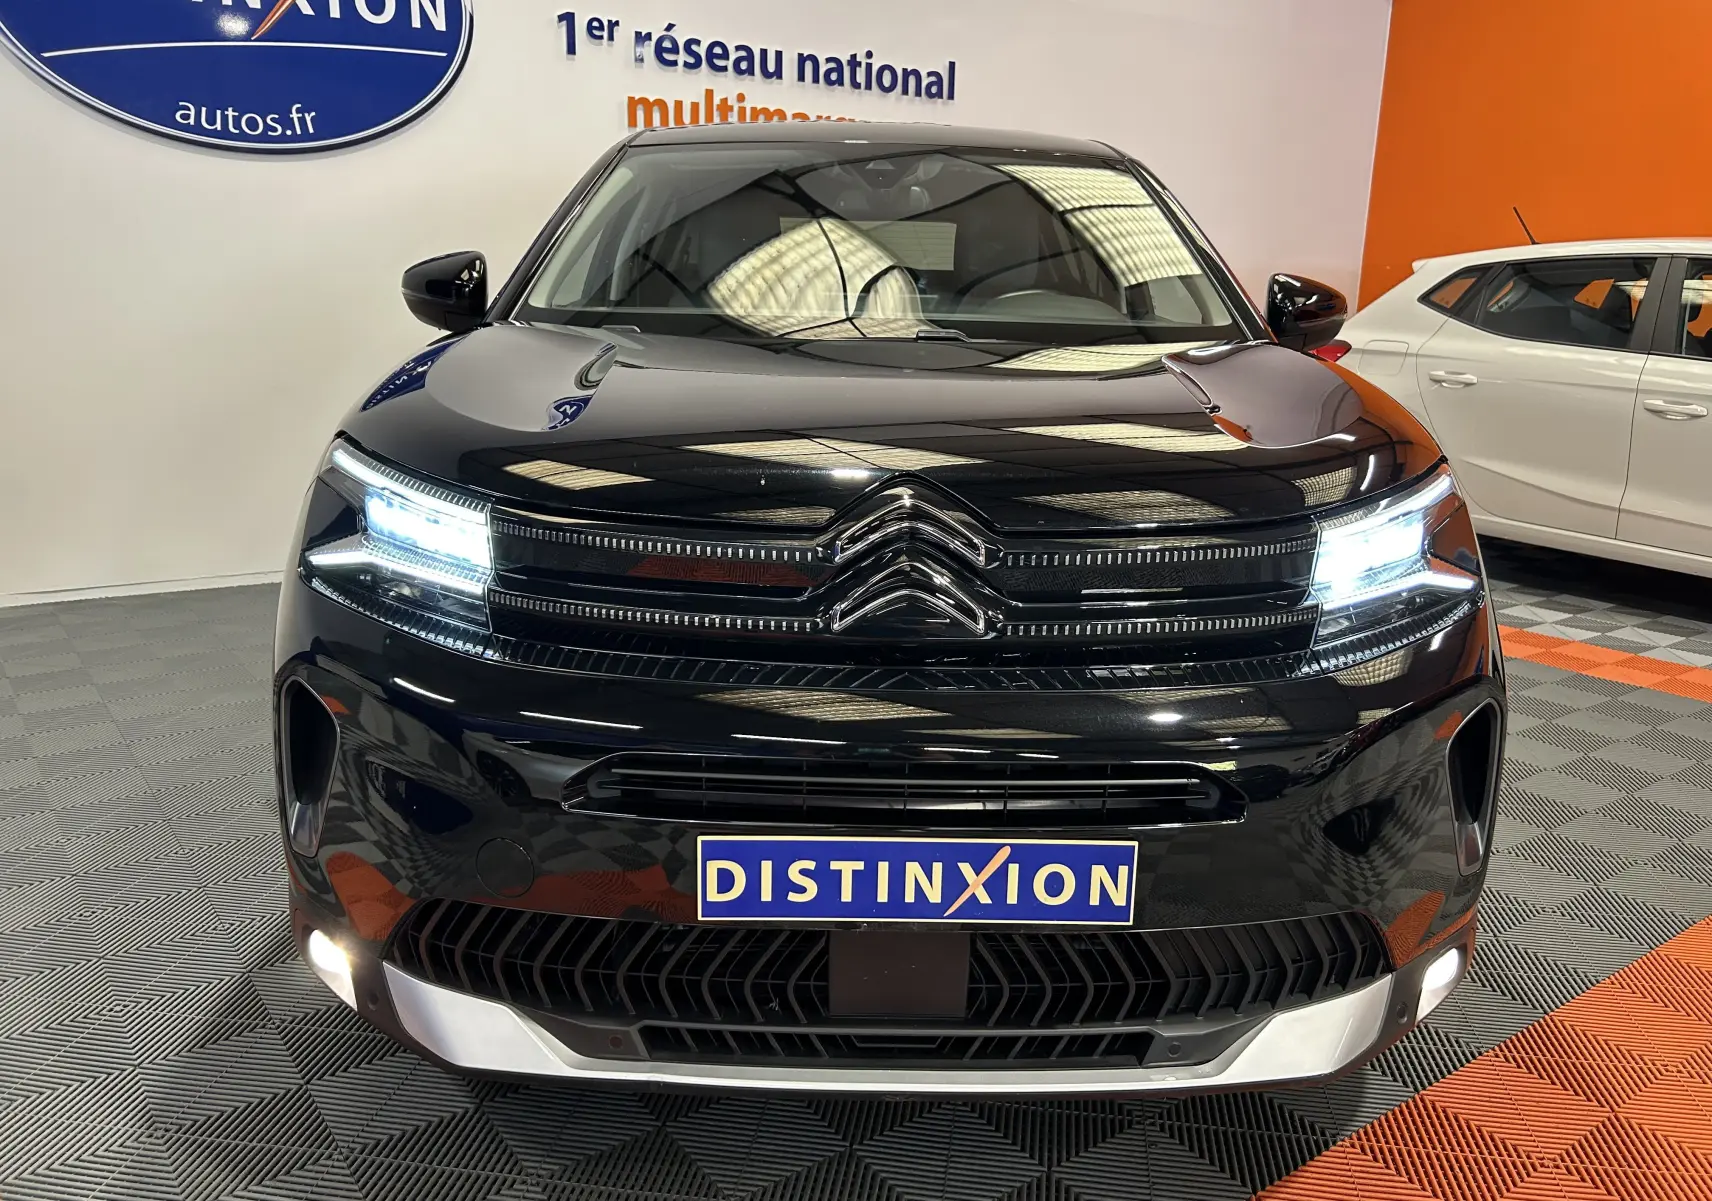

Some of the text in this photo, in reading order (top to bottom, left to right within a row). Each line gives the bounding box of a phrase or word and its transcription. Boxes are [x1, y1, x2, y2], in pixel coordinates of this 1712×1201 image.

[634, 23, 784, 80] réseau
[797, 50, 956, 100] national
[174, 101, 316, 136] autos.fr
[705, 845, 1130, 917] DISTINXION
